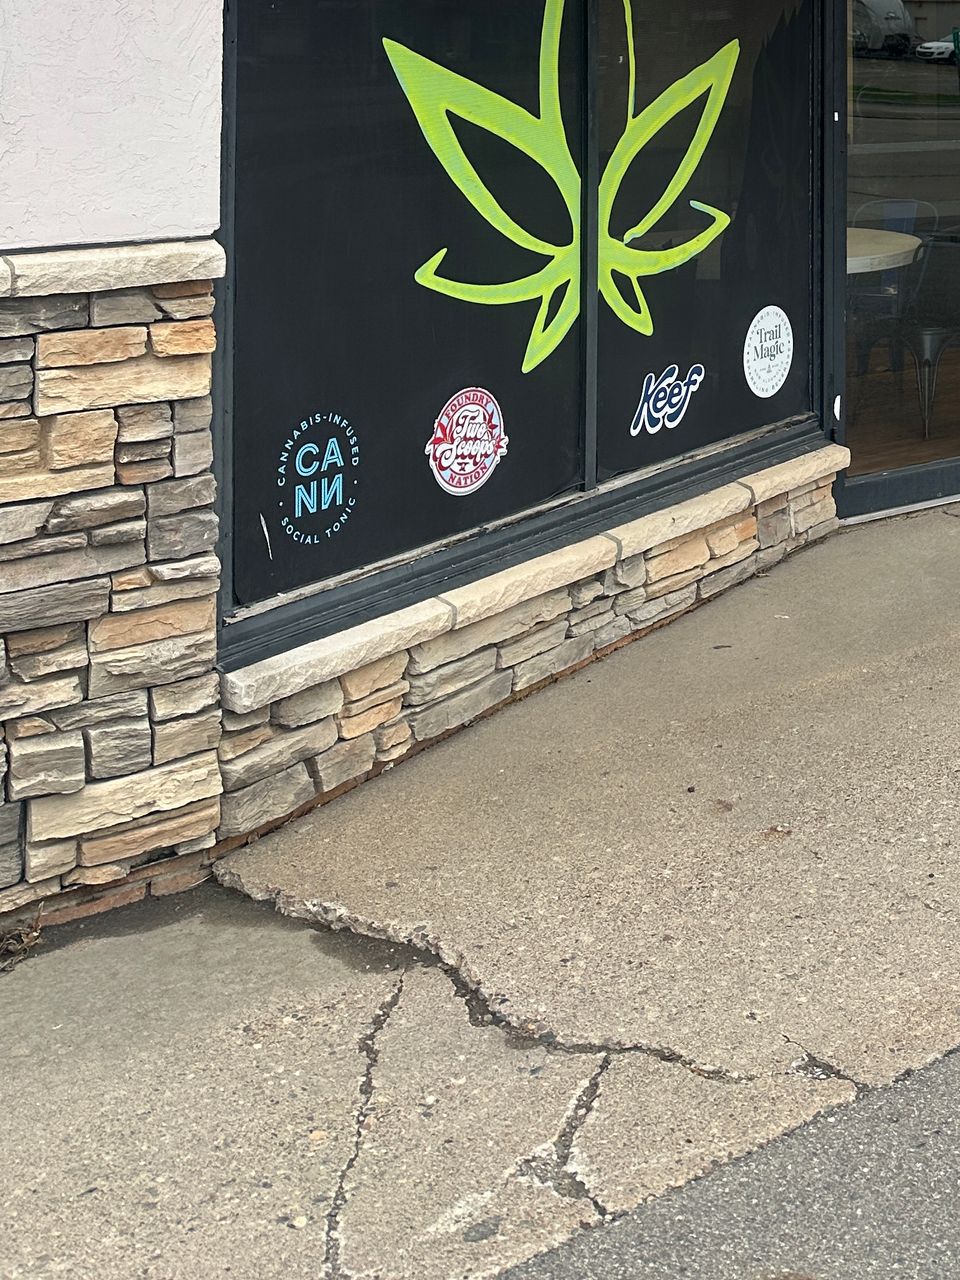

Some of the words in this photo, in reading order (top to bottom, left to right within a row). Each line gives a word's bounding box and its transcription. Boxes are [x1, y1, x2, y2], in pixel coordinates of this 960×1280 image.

[756, 324, 782, 343] Trail
[753, 340, 785, 361] Magic
[445, 393, 492, 420] FOUNDRY
[630, 363, 705, 437] Keef
[453, 409, 488, 438] Two
[277, 412, 359, 487] CANNABIS-INFUSED
[435, 436, 496, 471] Scoops
[448, 463, 488, 486] NATION
[281, 517, 320, 545] SOCIAL
[325, 497, 356, 538] TONIC
